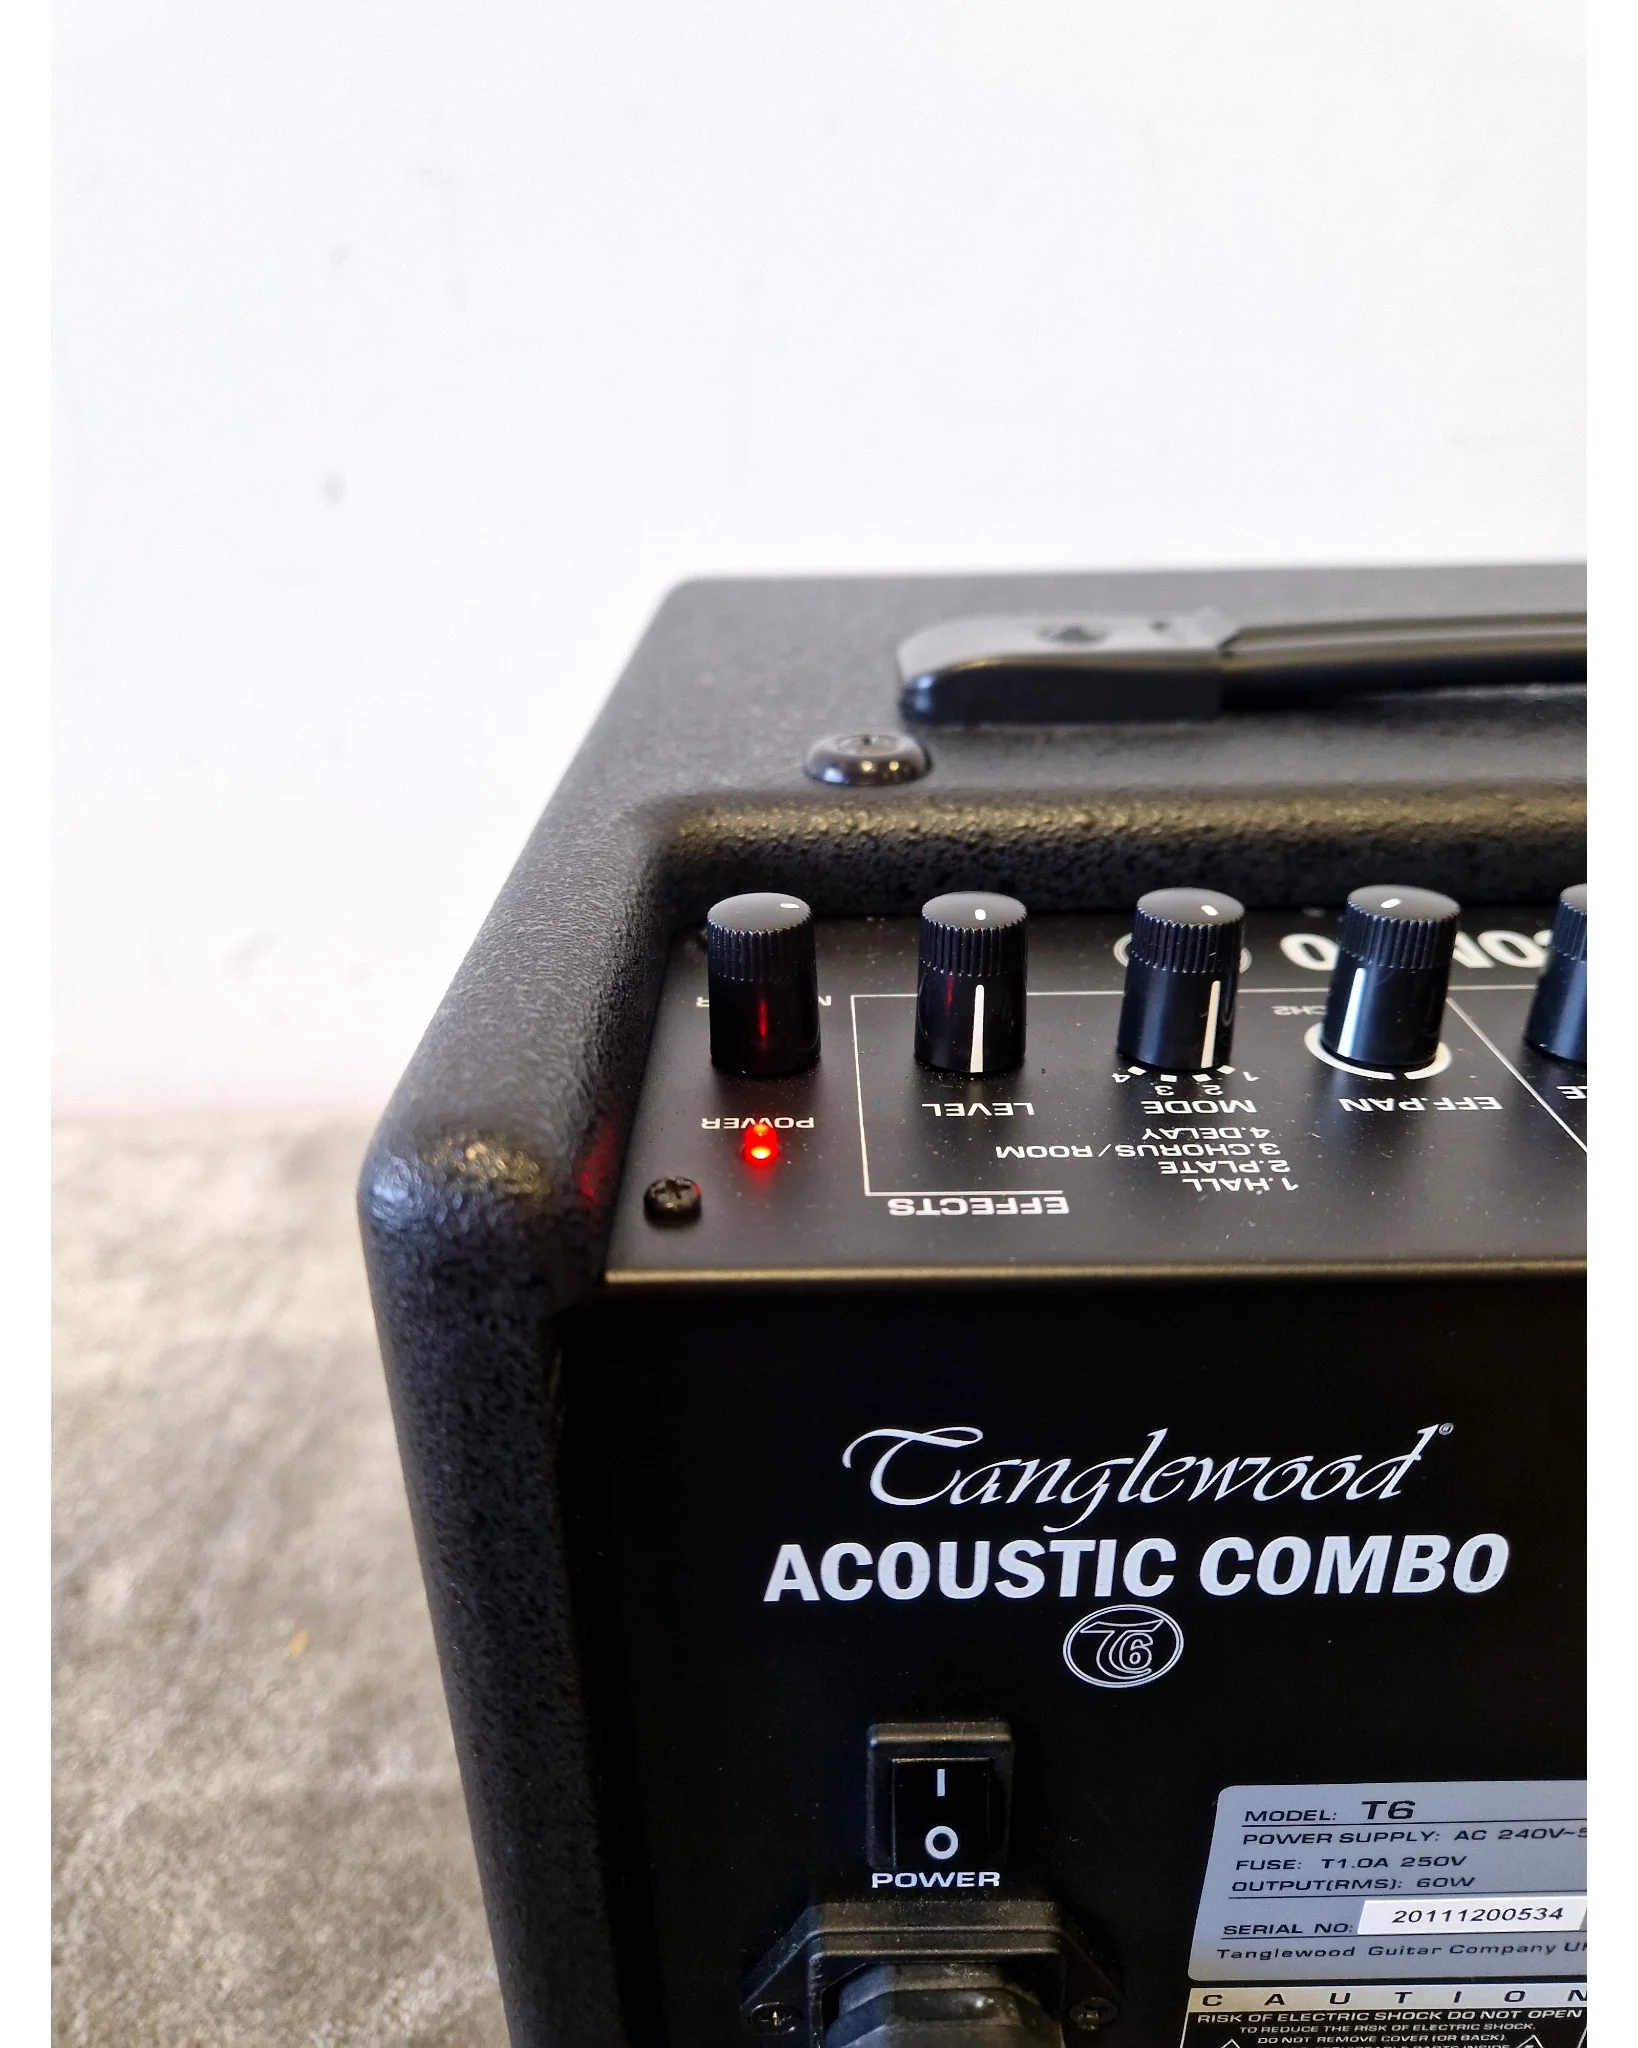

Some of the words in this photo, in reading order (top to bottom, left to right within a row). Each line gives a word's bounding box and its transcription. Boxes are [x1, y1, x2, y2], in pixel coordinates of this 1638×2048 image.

[1112, 1072, 1131, 1084] 4
[1243, 1071, 1260, 1082] 1
[1155, 1085, 1174, 1096] 3
[1202, 1085, 1224, 1096] 2
[922, 1102, 1035, 1117] LEVEL
[1141, 1100, 1257, 1115] MODE
[701, 1117, 815, 1129] POWER
[1142, 1127, 1271, 1140] 4.DELAY
[1157, 1160, 1291, 1175] 2.PLATE
[1182, 1177, 1299, 1193] 1.HALL
[887, 1197, 1070, 1217] EFFECTS
[842, 1423, 1439, 1532] Tanglewood
[763, 1538, 1177, 1602] ACOUSTIC
[1199, 1533, 1511, 1596] COMBO
[1244, 1810, 1337, 1822] MODEL:
[1361, 1800, 1416, 1820] T6
[1242, 1833, 1333, 1845] POWER
[1339, 1831, 1440, 1843] SUPPLY:
[1454, 1829, 1488, 1841] AC
[1235, 1859, 1301, 1871] FUSE:
[1321, 1857, 1389, 1870] T1.0A
[1400, 1855, 1468, 1868] 250V
[871, 1871, 1001, 1889] POWER
[1231, 1878, 1403, 1892] OUTPUT(RMS):
[1416, 1876, 1476, 1888] 60W
[1223, 1924, 1303, 1935] SERIAL
[1313, 1923, 1353, 1934] NO:
[1391, 1907, 1564, 1924] 20111200534
[1216, 1946, 1355, 1961] Tanglewood
[1368, 1943, 1443, 1956] Guitar
[1449, 1943, 1557, 1956] Company
[1197, 2014, 1243, 2024] RISK
[1248, 2014, 1274, 2024] OF
[1277, 2012, 1371, 2023] ELECTRIC
[1373, 2011, 1442, 2022] SHOCK
[1447, 2011, 1476, 2021] DO
[1480, 2010, 1522, 2020] NOT
[1527, 2009, 1583, 2019] OPEN
[1239, 2026, 1258, 2034] TO
[1261, 2025, 1319, 2034] REDUCE
[1323, 2025, 1350, 2033] THE
[1354, 2024, 1387, 2033] RISK
[1391, 2024, 1410, 2032] OF
[1412, 2023, 1480, 2032] ELECTRIC
[1281, 2036, 1312, 2044] NOT
[1316, 2035, 1377, 2043] REMOVE
